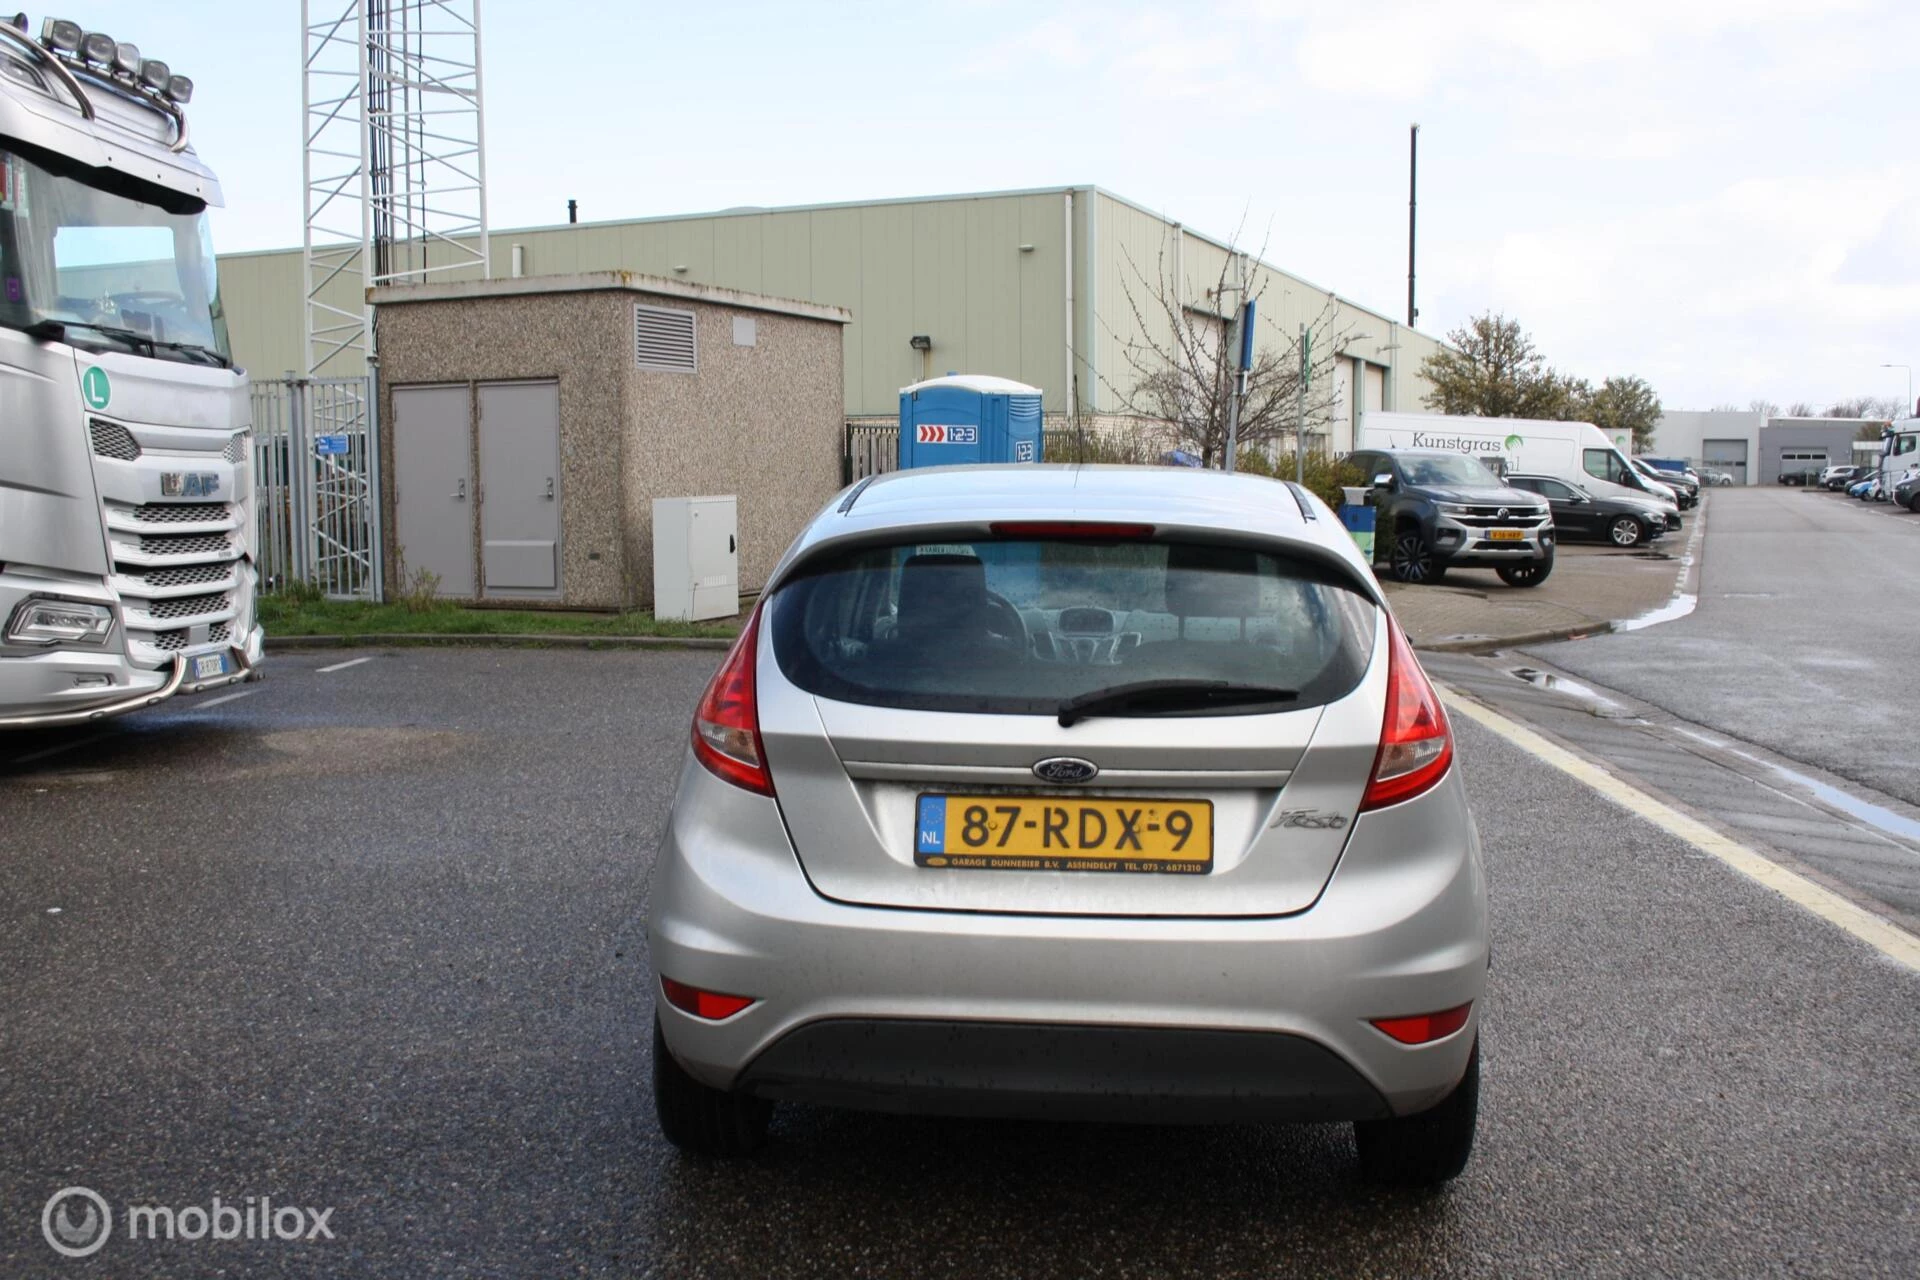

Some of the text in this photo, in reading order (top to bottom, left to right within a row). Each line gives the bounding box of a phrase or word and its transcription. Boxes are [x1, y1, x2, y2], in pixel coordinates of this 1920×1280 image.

[90, 373, 105, 403] L
[1412, 432, 1501, 454] Kunstgras
[1046, 763, 1083, 777] Ford
[961, 805, 1194, 851] 87-RDX-9
[921, 831, 940, 845] NL
[951, 857, 986, 866] GARAGE
[1066, 861, 1117, 870] ASSENDELFT
[1124, 862, 1141, 870] TEL.
